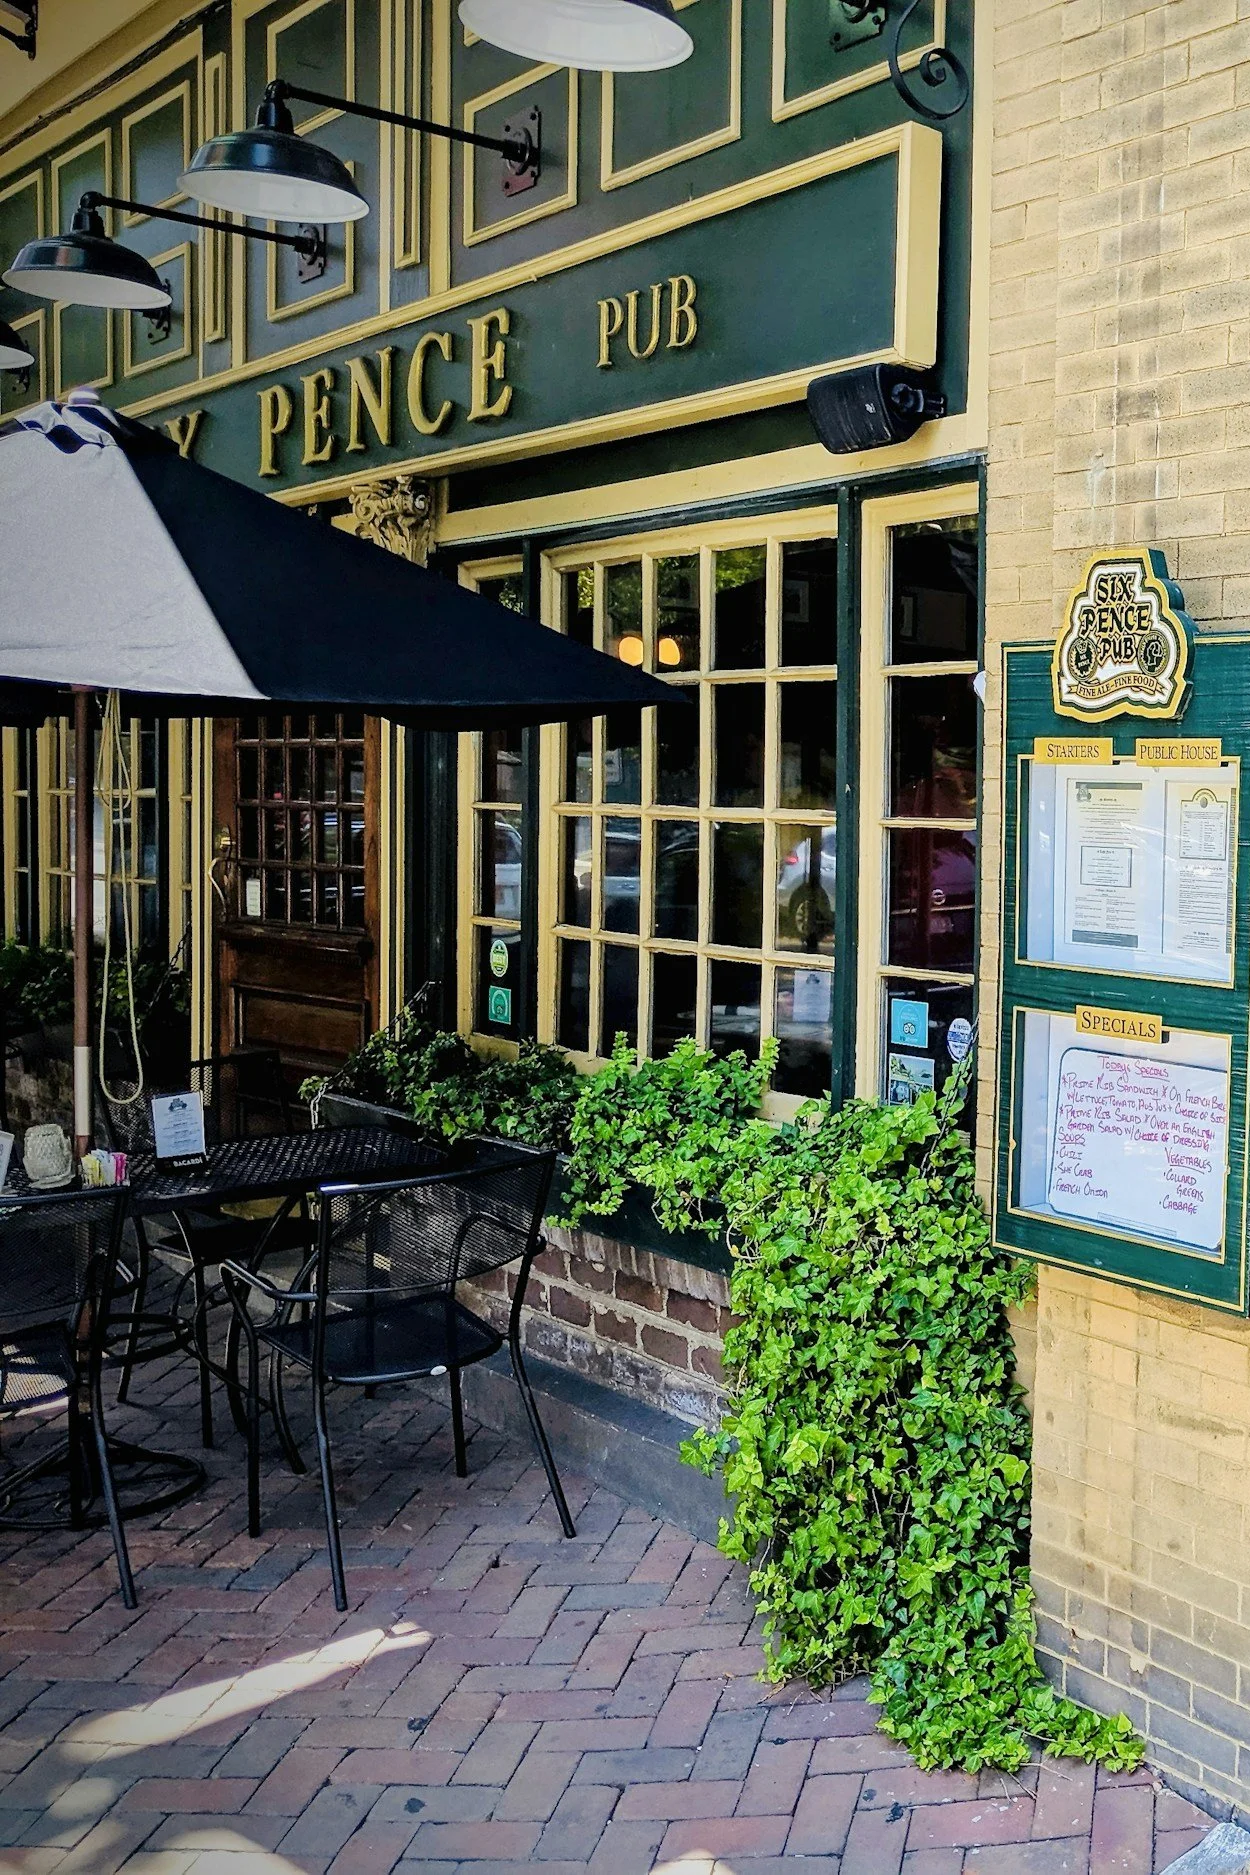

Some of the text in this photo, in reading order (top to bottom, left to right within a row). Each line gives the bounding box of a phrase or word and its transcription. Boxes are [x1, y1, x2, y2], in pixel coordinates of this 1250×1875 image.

[257, 274, 698, 478] PENCE PUB
[1097, 575, 1134, 604] SIX
[1080, 605, 1150, 637] PENCE
[1099, 638, 1136, 661] PUB
[1079, 684, 1096, 697] FINE
[1132, 675, 1156, 688] FOOD
[1047, 743, 1100, 758] STARTERS
[1140, 744, 1219, 760] PUBLIC HOUSE
[1081, 1010, 1156, 1038] SPECIALS
